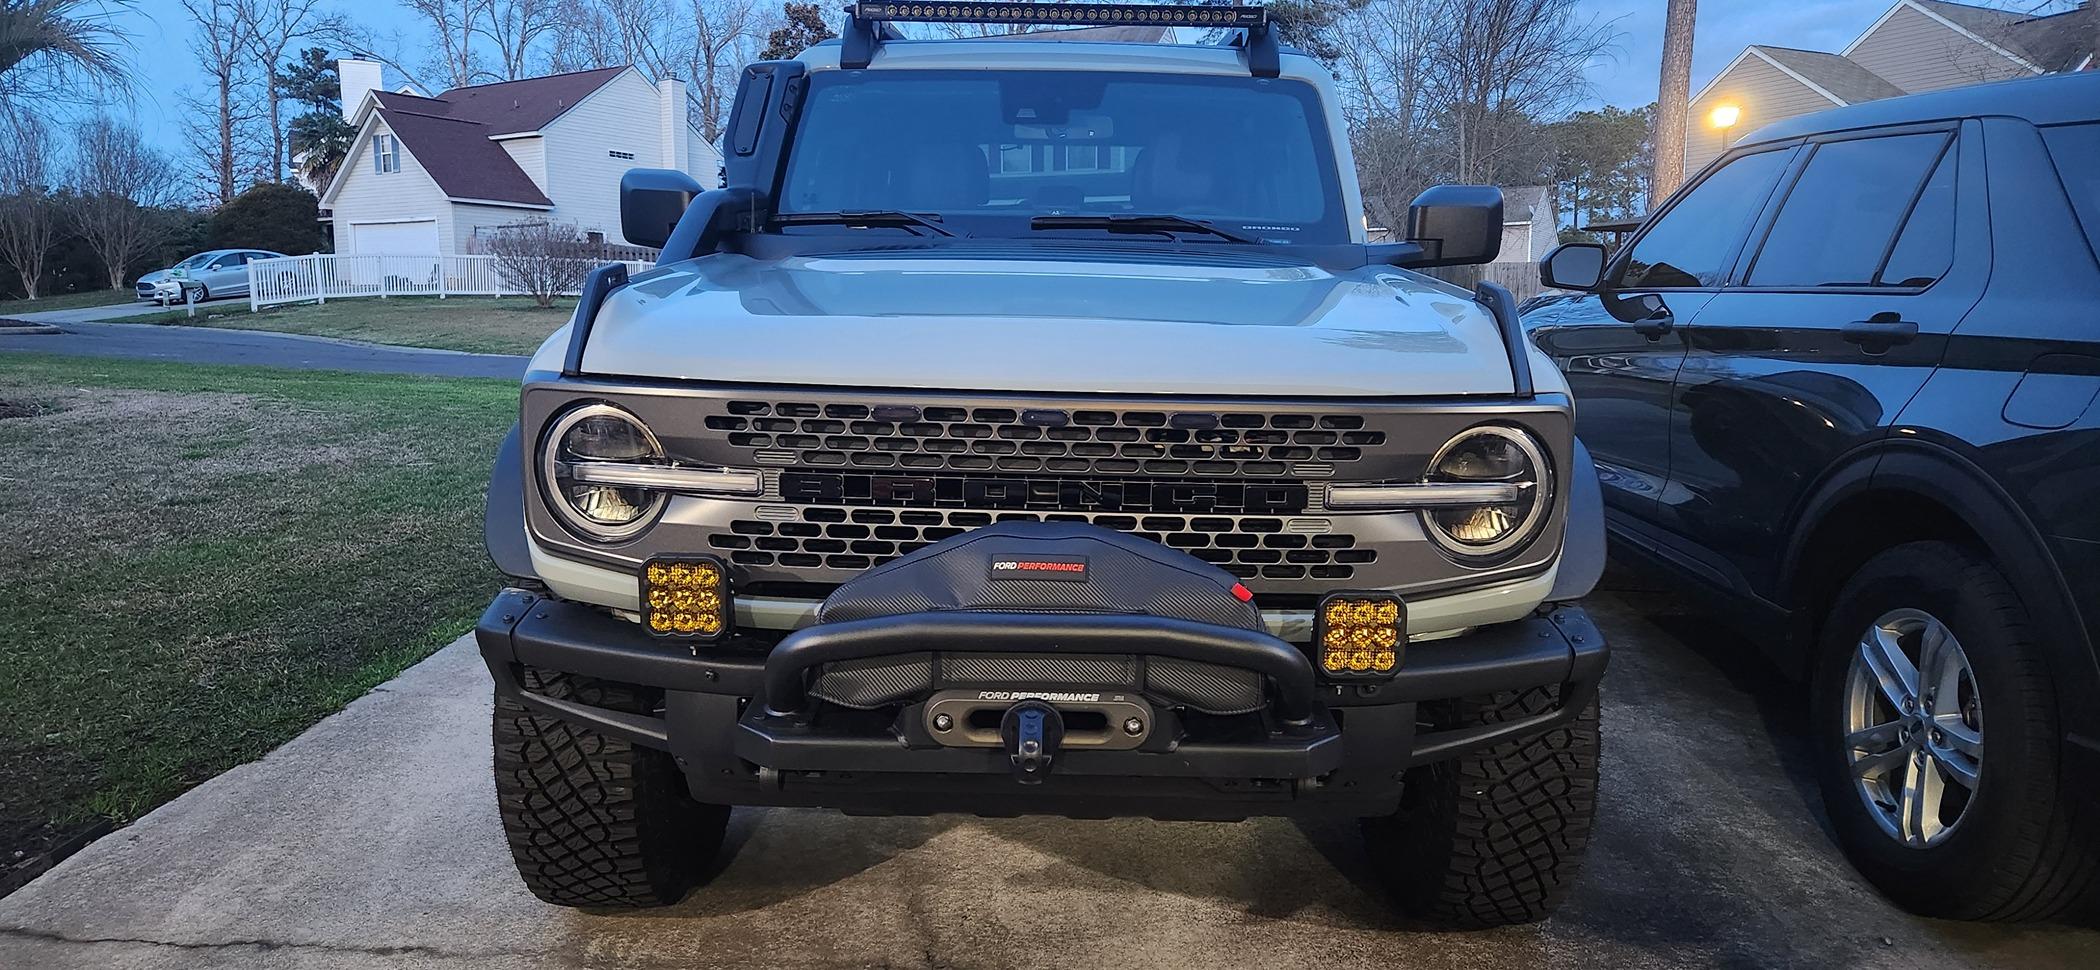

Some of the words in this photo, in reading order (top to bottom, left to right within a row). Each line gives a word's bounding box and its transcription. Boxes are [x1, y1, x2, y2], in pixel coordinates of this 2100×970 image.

[779, 472, 1309, 512] BRONCO
[993, 562, 1017, 570] FORD
[1017, 562, 1085, 572] PERFORMANCE
[978, 691, 1010, 700] FORD
[1010, 692, 1100, 702] PERFORMANCE
